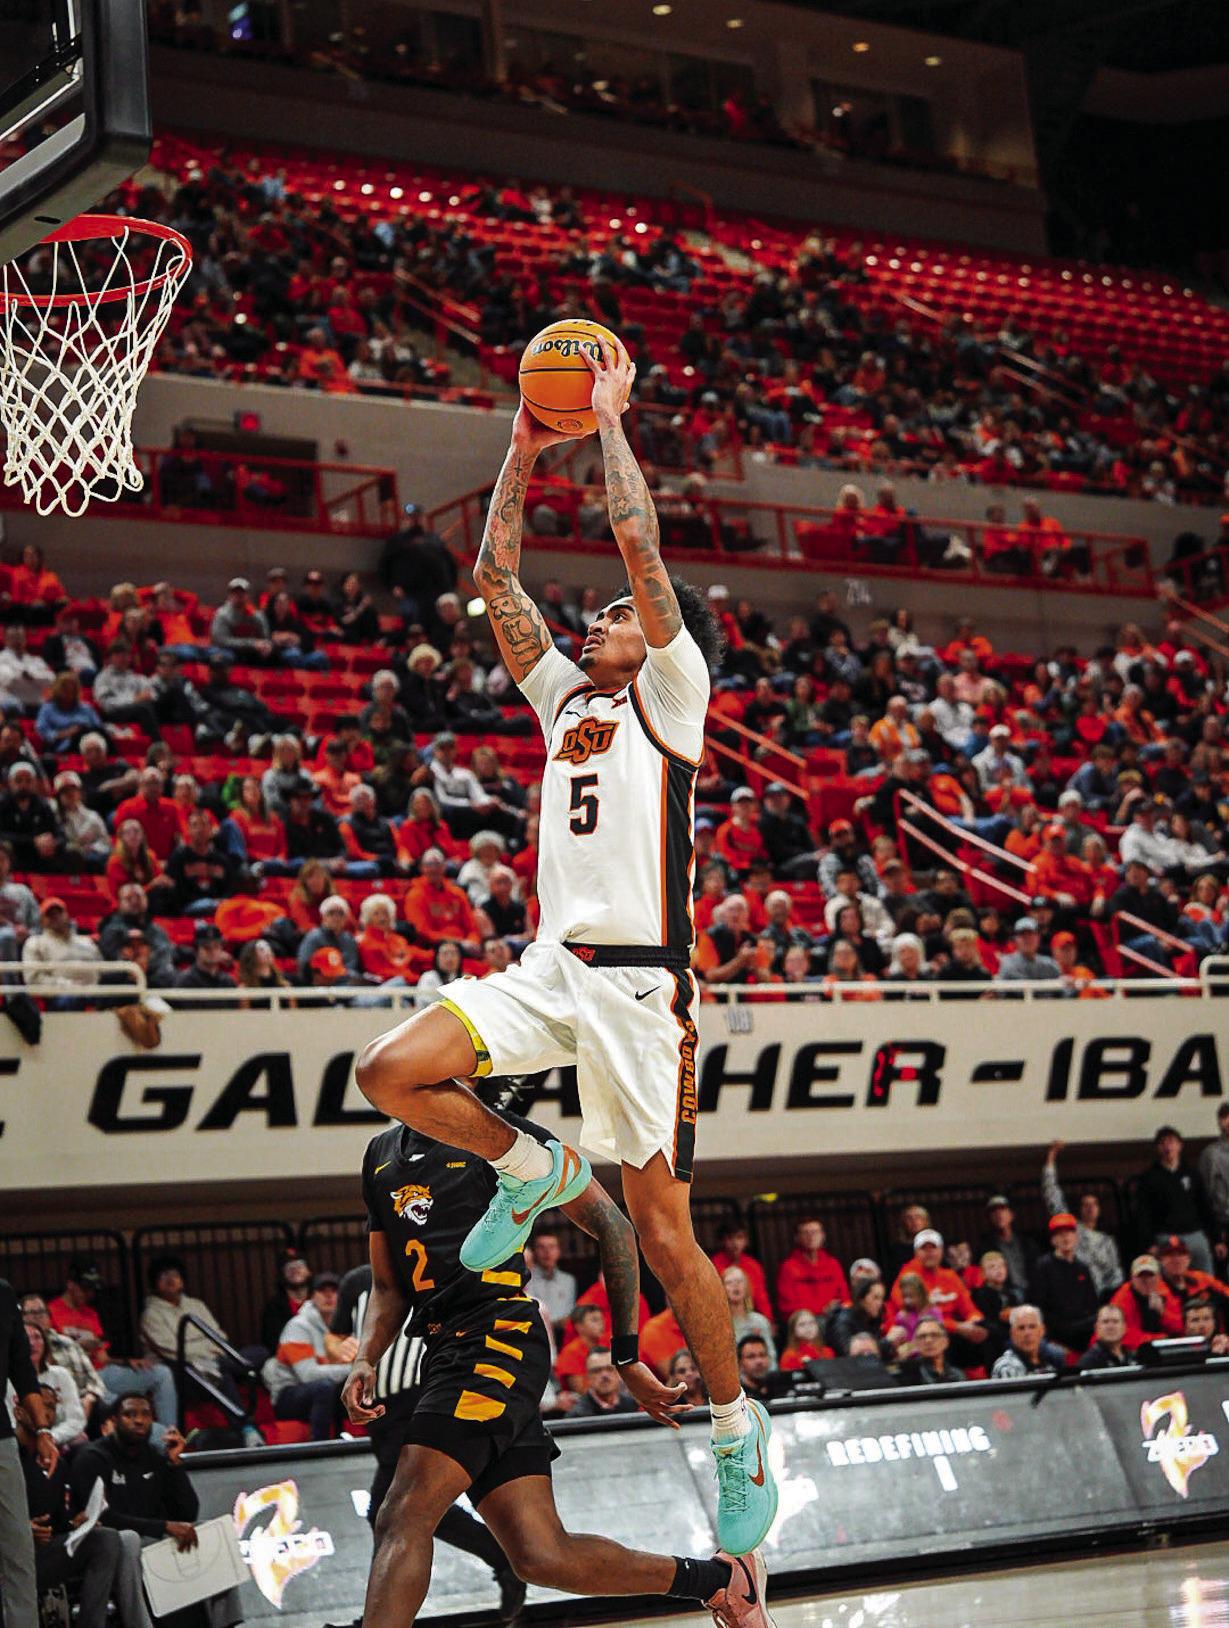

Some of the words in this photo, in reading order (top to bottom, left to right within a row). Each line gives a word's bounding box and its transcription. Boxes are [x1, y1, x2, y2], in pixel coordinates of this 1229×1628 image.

[552, 715, 620, 766] OSU
[569, 773, 599, 836] 5
[87, 1040, 946, 1134] GALAHER
[1045, 1034, 1223, 1101] IBA
[405, 1239, 436, 1292] 2
[826, 1425, 991, 1467] REDEFINING
